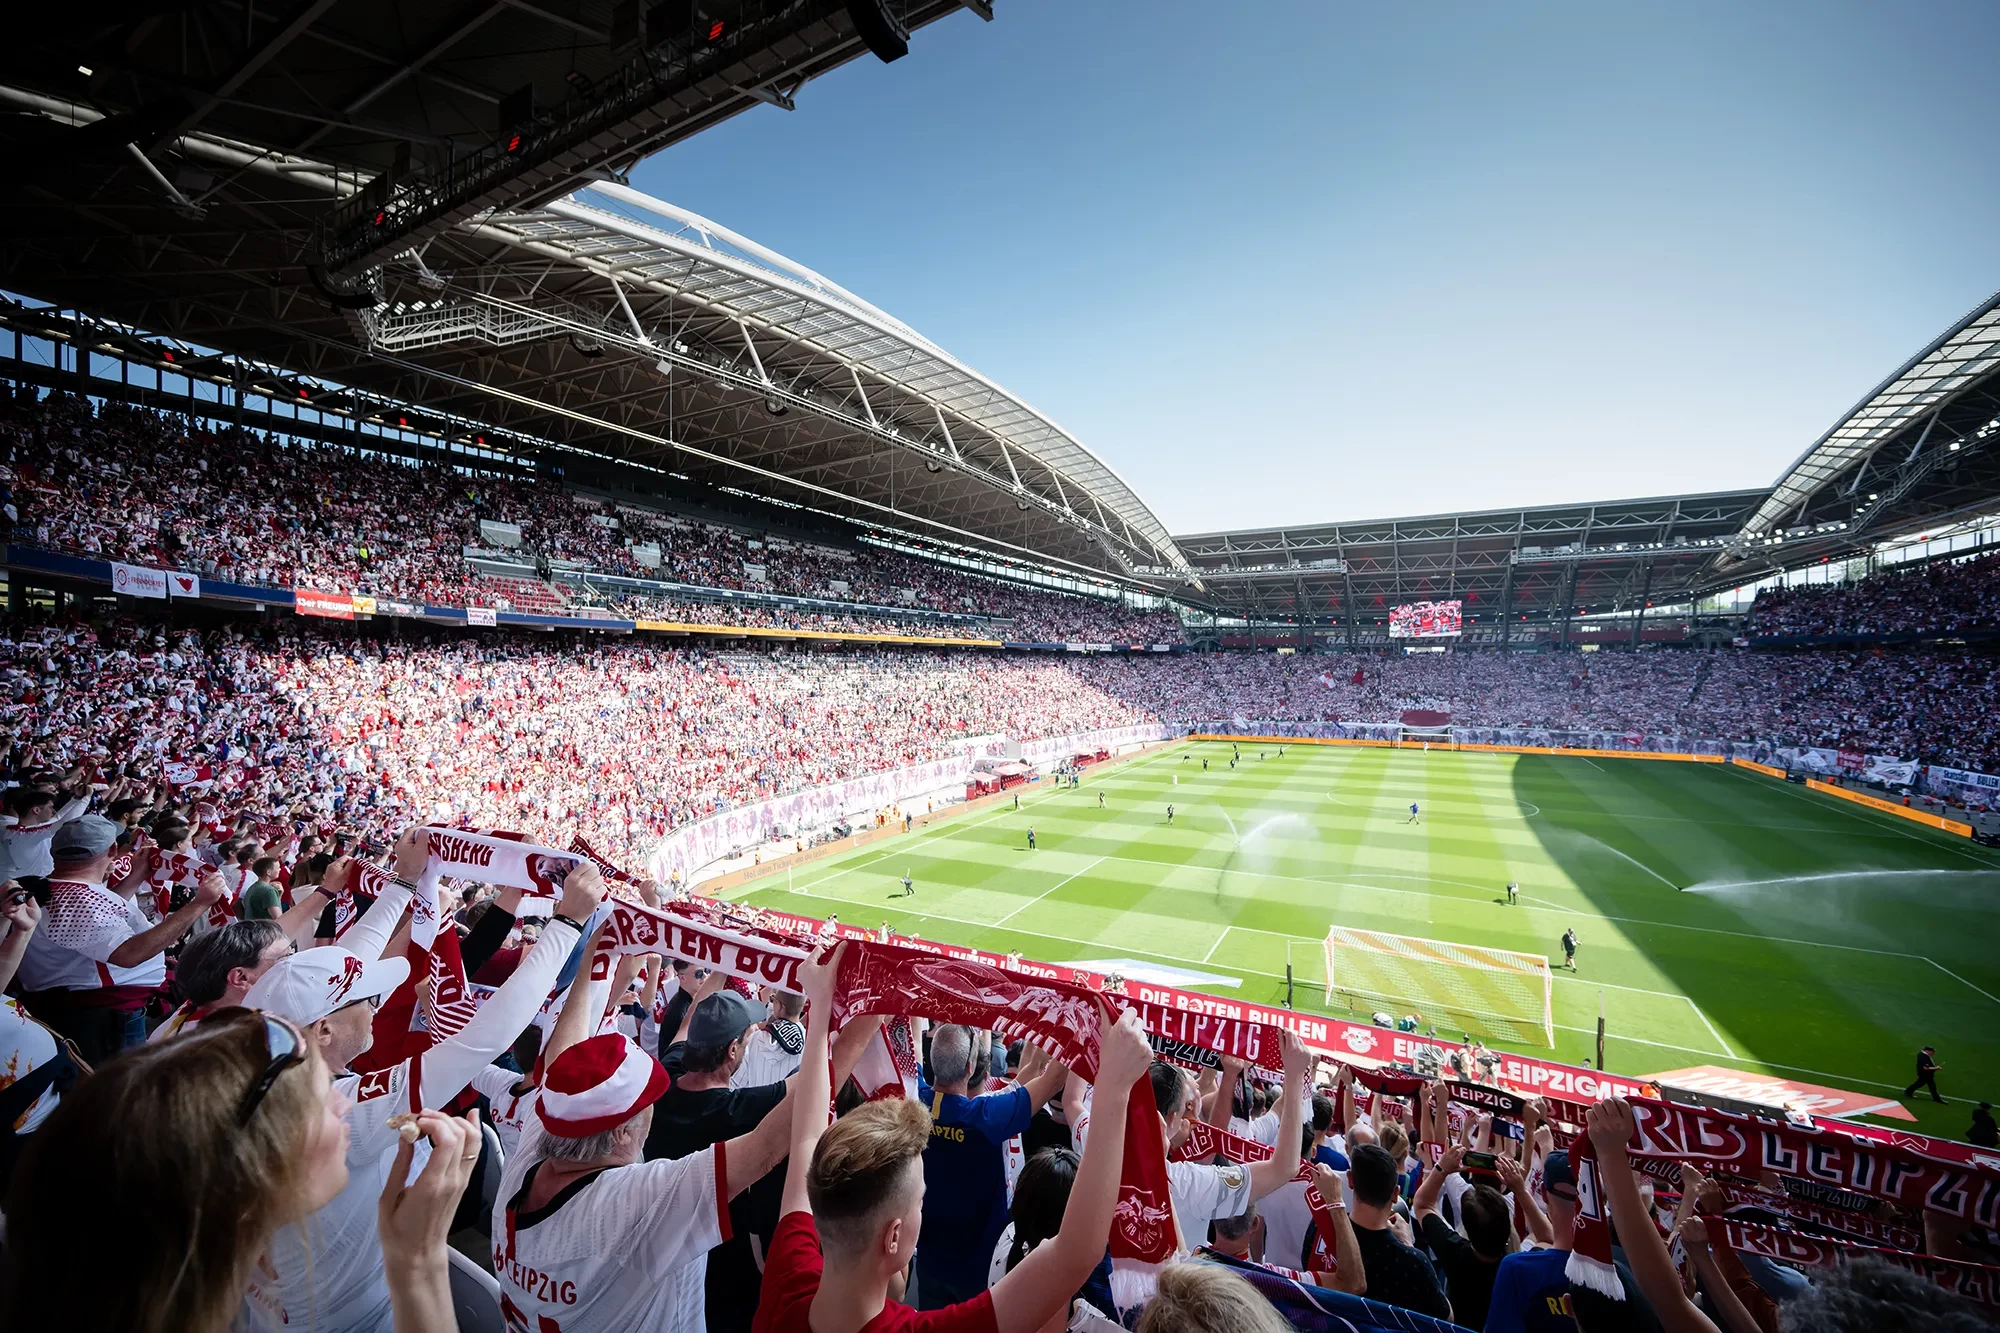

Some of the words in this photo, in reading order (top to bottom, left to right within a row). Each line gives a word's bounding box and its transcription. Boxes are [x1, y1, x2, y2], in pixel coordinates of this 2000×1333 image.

[614, 908, 729, 965] ROTEN
[1139, 987, 1171, 1006] DIE
[1142, 1004, 1262, 1061] LEIPZIG
[1451, 1087, 1513, 1110] LEIPZIG
[1497, 1057, 1598, 1098] LEIPZIG
[1761, 1131, 2000, 1232] LEIPZI
